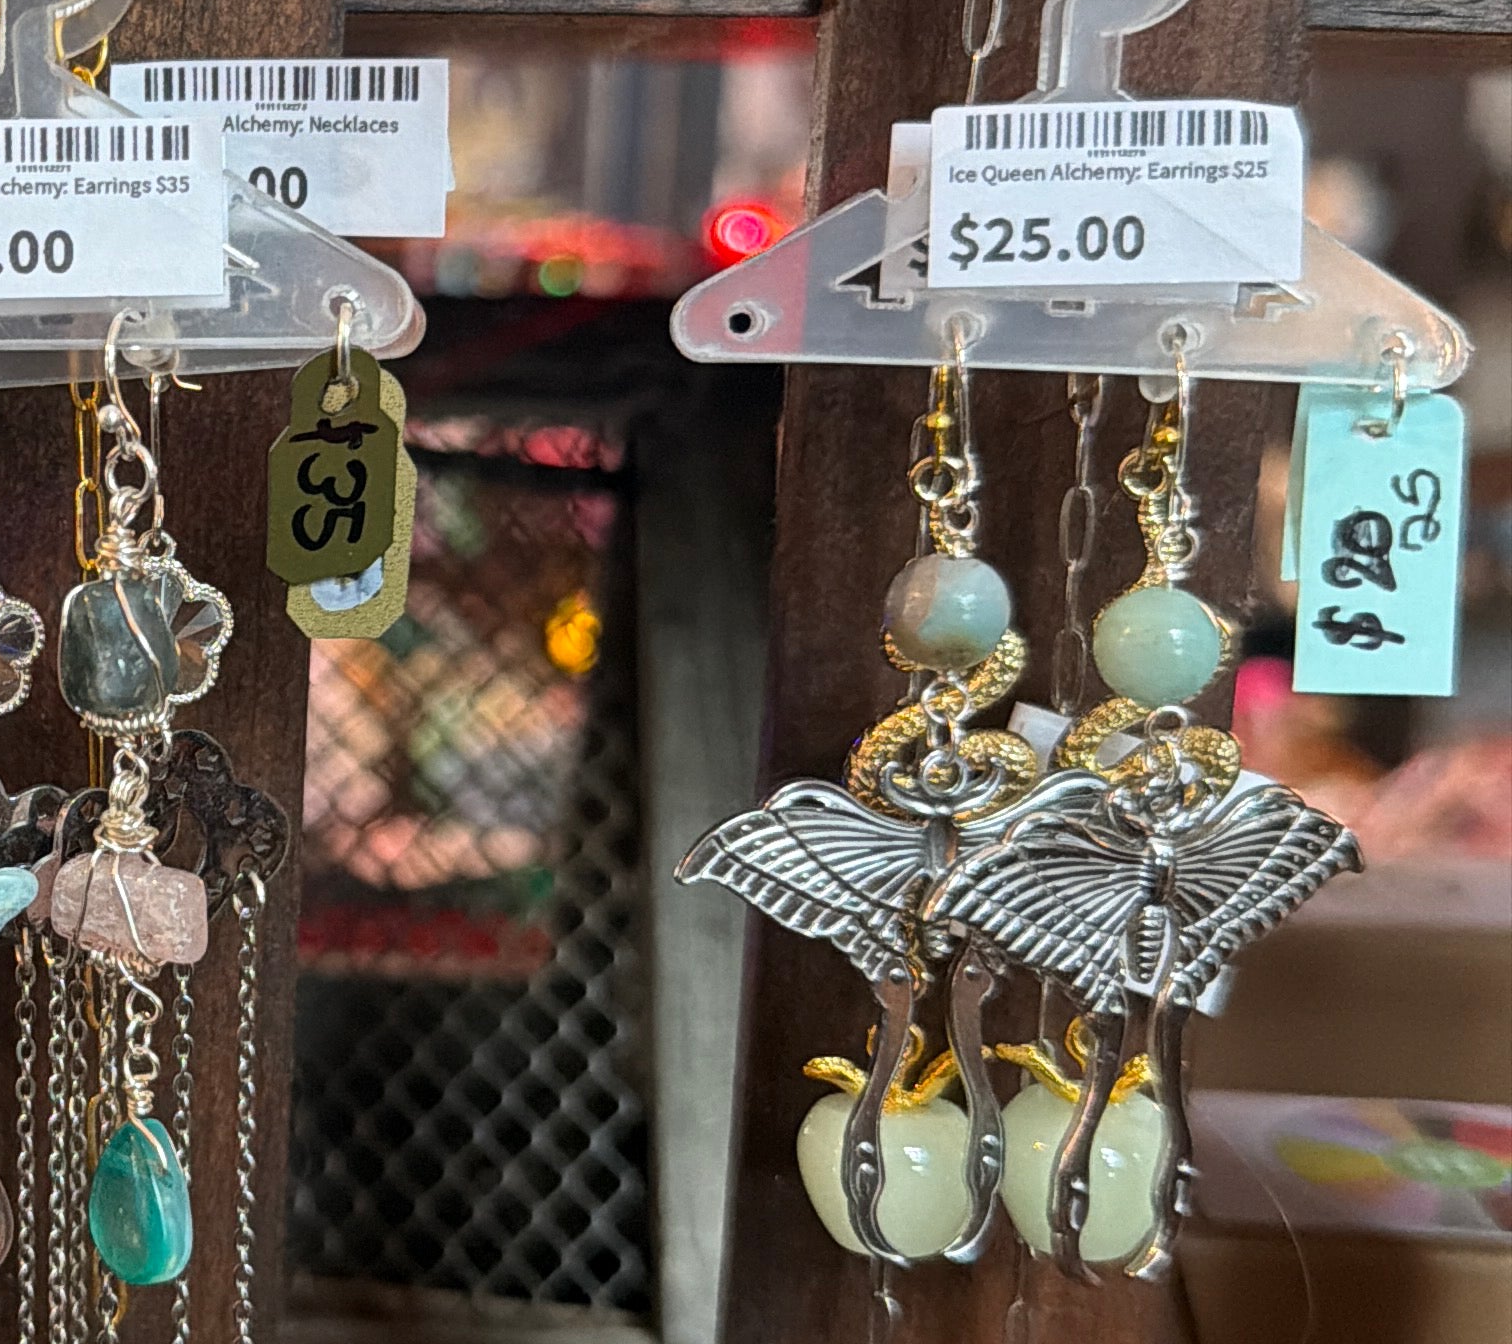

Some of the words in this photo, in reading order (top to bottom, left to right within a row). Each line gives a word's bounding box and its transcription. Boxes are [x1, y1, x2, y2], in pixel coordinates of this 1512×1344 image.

[222, 115, 303, 136] Alchemy:
[309, 115, 399, 134] Necklaces
[949, 166, 976, 184] Ice
[981, 164, 1046, 186] Queen
[1050, 162, 1142, 185] Alchemy:
[1148, 161, 1229, 182] Earrings
[1233, 160, 1268, 179] $25
[74, 175, 152, 198] Earrings
[155, 174, 190, 195] $35
[949, 212, 1145, 271] $25.00
